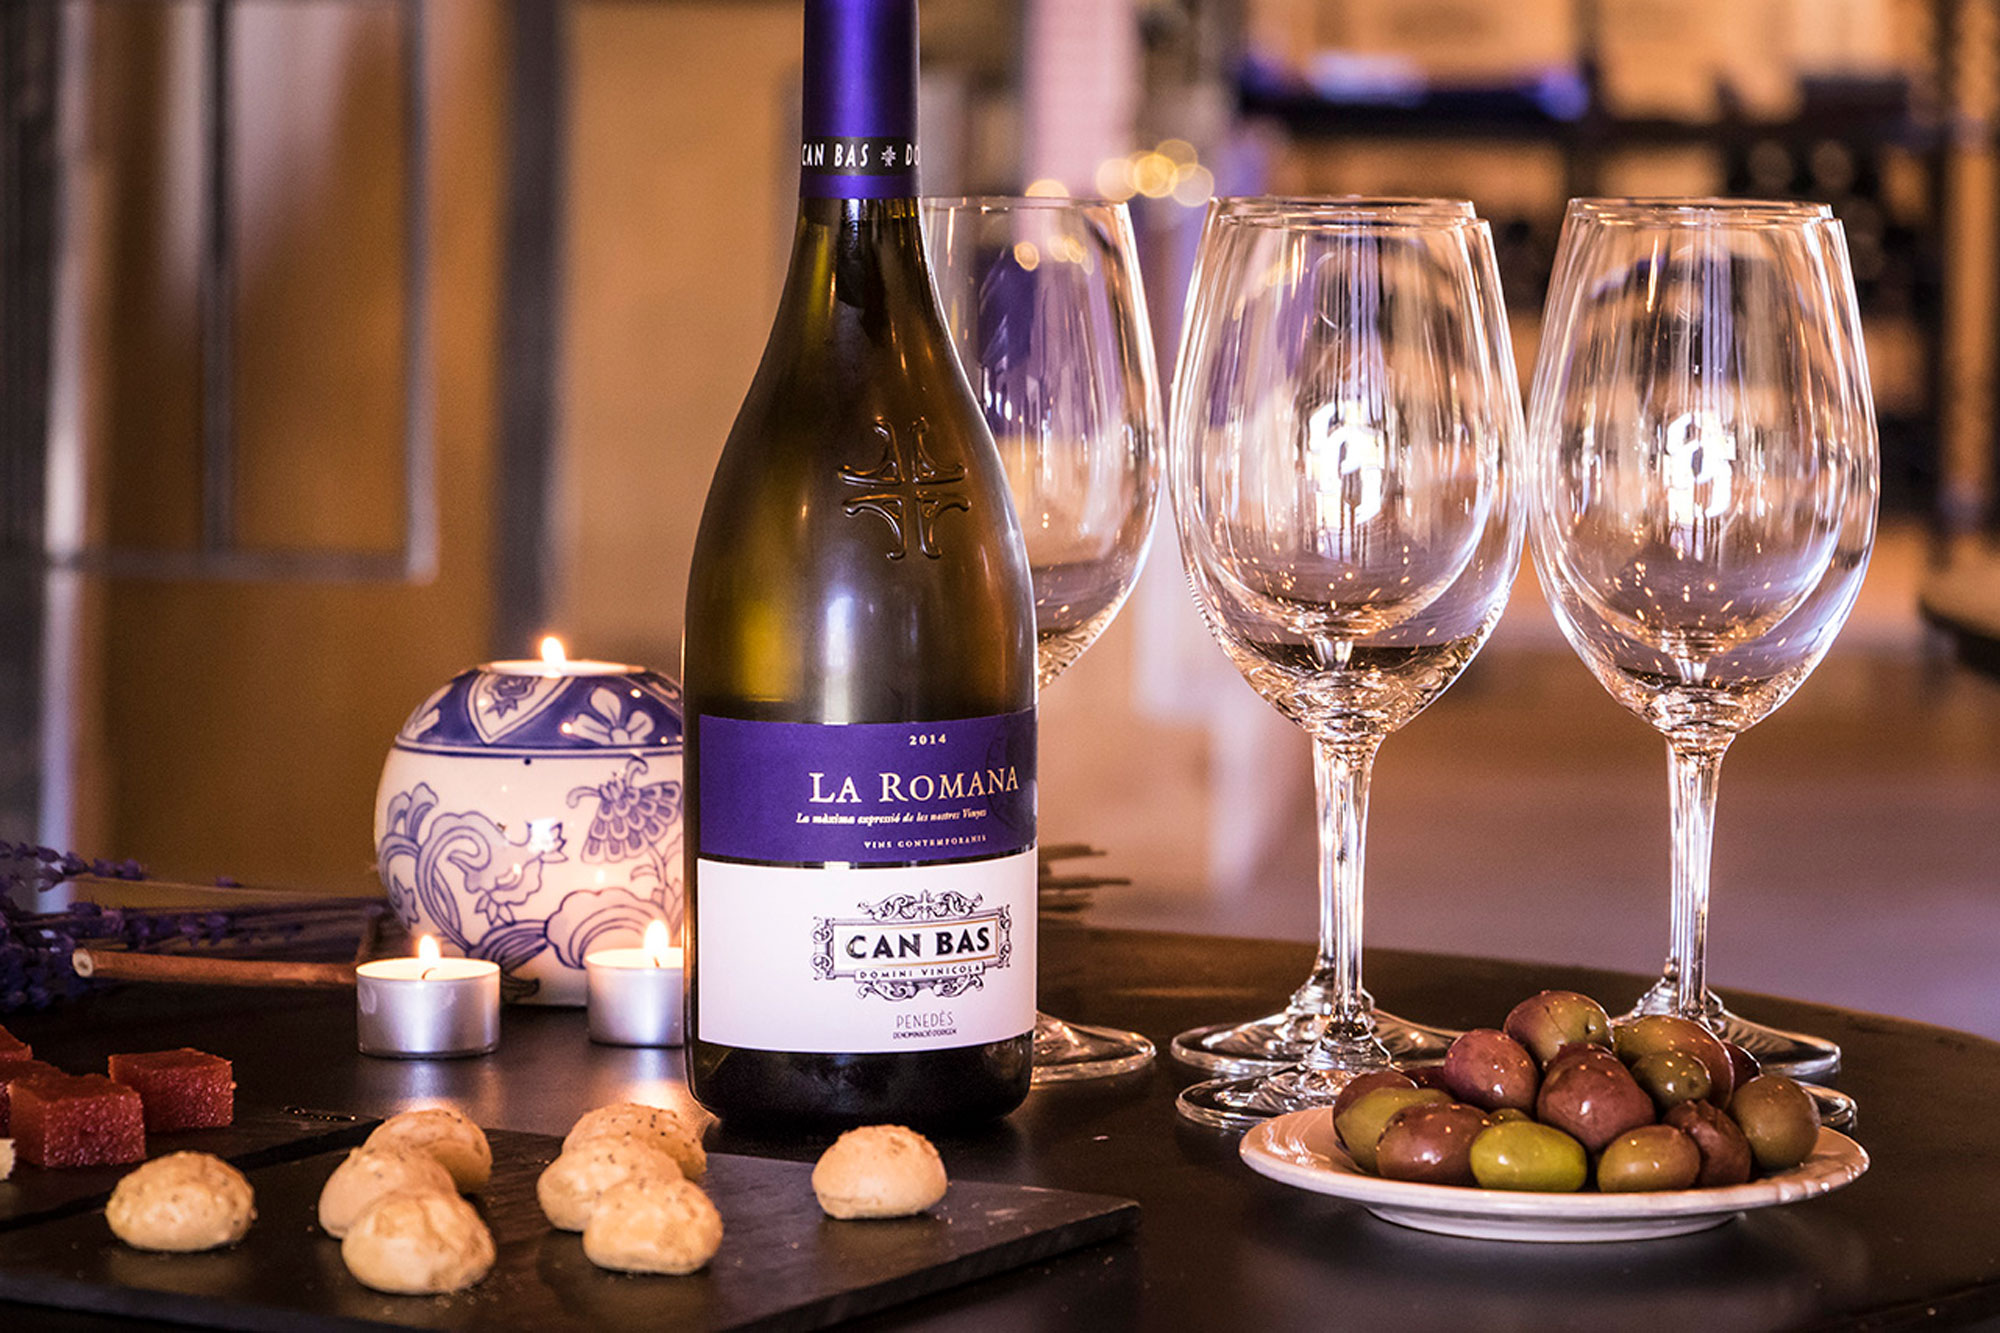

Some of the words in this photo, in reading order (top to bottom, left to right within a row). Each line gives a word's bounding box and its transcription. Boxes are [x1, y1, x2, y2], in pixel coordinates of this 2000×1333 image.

[801, 143, 825, 166] CAN
[834, 143, 869, 168] BAS
[909, 733, 947, 746] 2014
[796, 812, 810, 823] La
[902, 811, 914, 823] de
[916, 811, 928, 822] les
[864, 841, 892, 849] VINS
[846, 933, 921, 959] CAN
[935, 926, 990, 956] BAS
[860, 970, 913, 979] DOMINI
